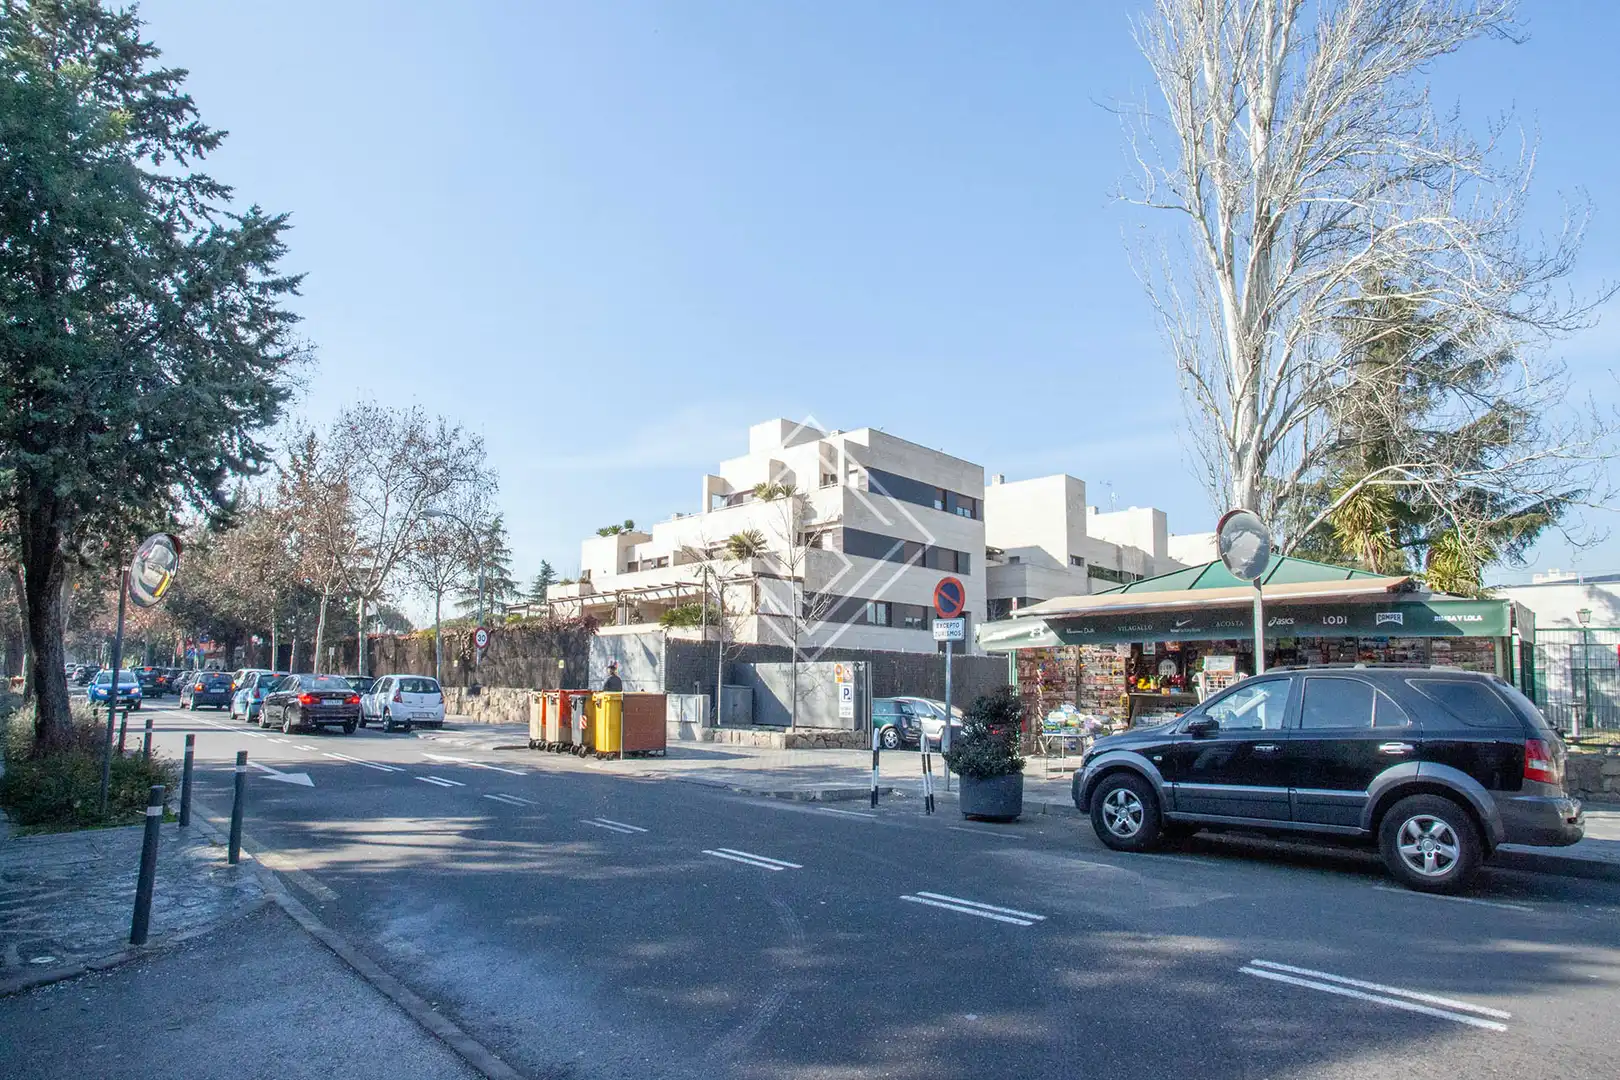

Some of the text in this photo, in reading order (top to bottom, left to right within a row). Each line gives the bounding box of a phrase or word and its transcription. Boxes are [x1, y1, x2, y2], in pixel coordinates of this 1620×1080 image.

[1322, 616, 1347, 625] LODI
[1377, 613, 1402, 622] CAMPER
[477, 634, 486, 642] 30
[844, 688, 850, 700] P
